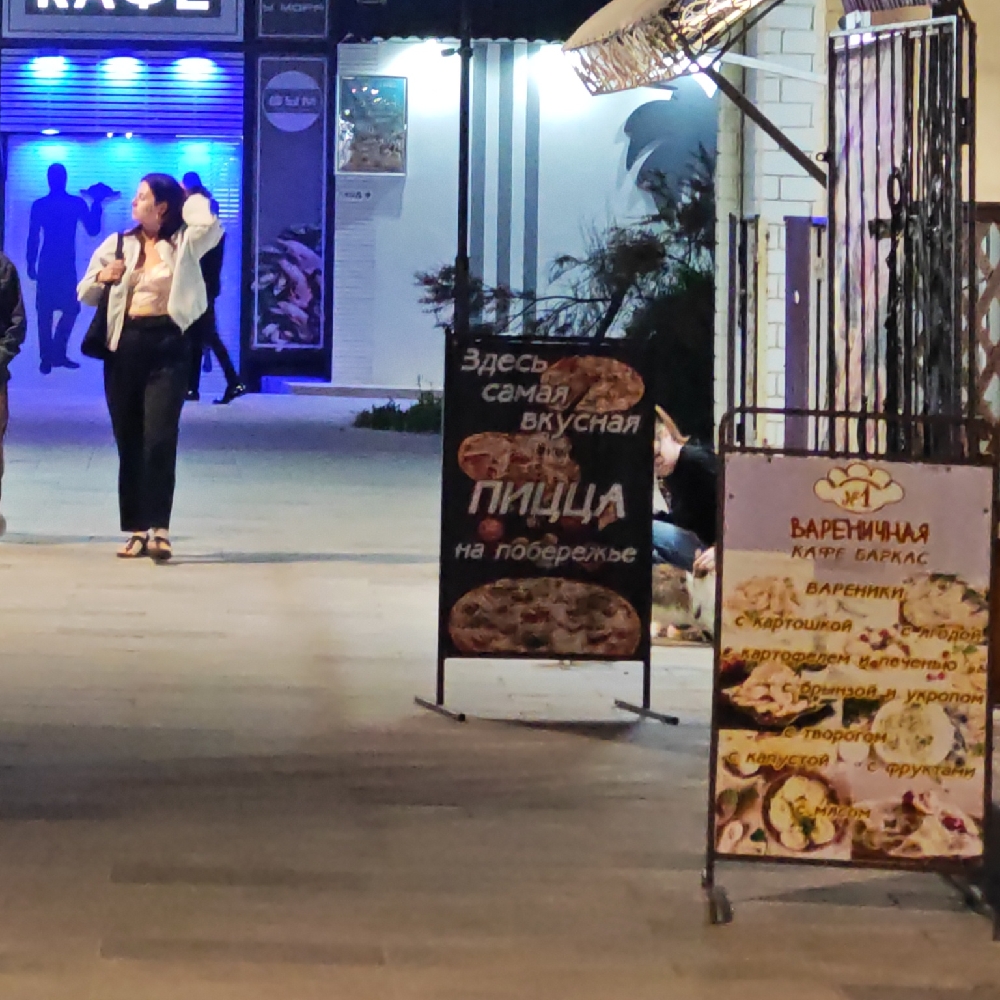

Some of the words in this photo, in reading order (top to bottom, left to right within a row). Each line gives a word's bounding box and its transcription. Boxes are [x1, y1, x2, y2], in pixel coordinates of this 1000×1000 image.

[460, 347, 549, 377] Здесь
[481, 382, 570, 404] самая
[520, 411, 642, 440] вкусная
[468, 479, 627, 525] ПИЦЦА
[790, 517, 930, 544] ВАРЕНИЧНАЯ
[454, 543, 485, 561] на
[494, 541, 639, 567] побережье
[790, 545, 846, 561] КАФЕ
[854, 548, 931, 566] БАРКАС
[805, 581, 906, 600] ВАРЕНИКИ
[750, 614, 854, 634] картошкой
[741, 647, 851, 667] картофелем
[800, 680, 878, 700] брынзой
[906, 686, 985, 706] укропом
[803, 727, 888, 745] творогом
[745, 750, 830, 771] капустой
[884, 760, 977, 779] фруктами
